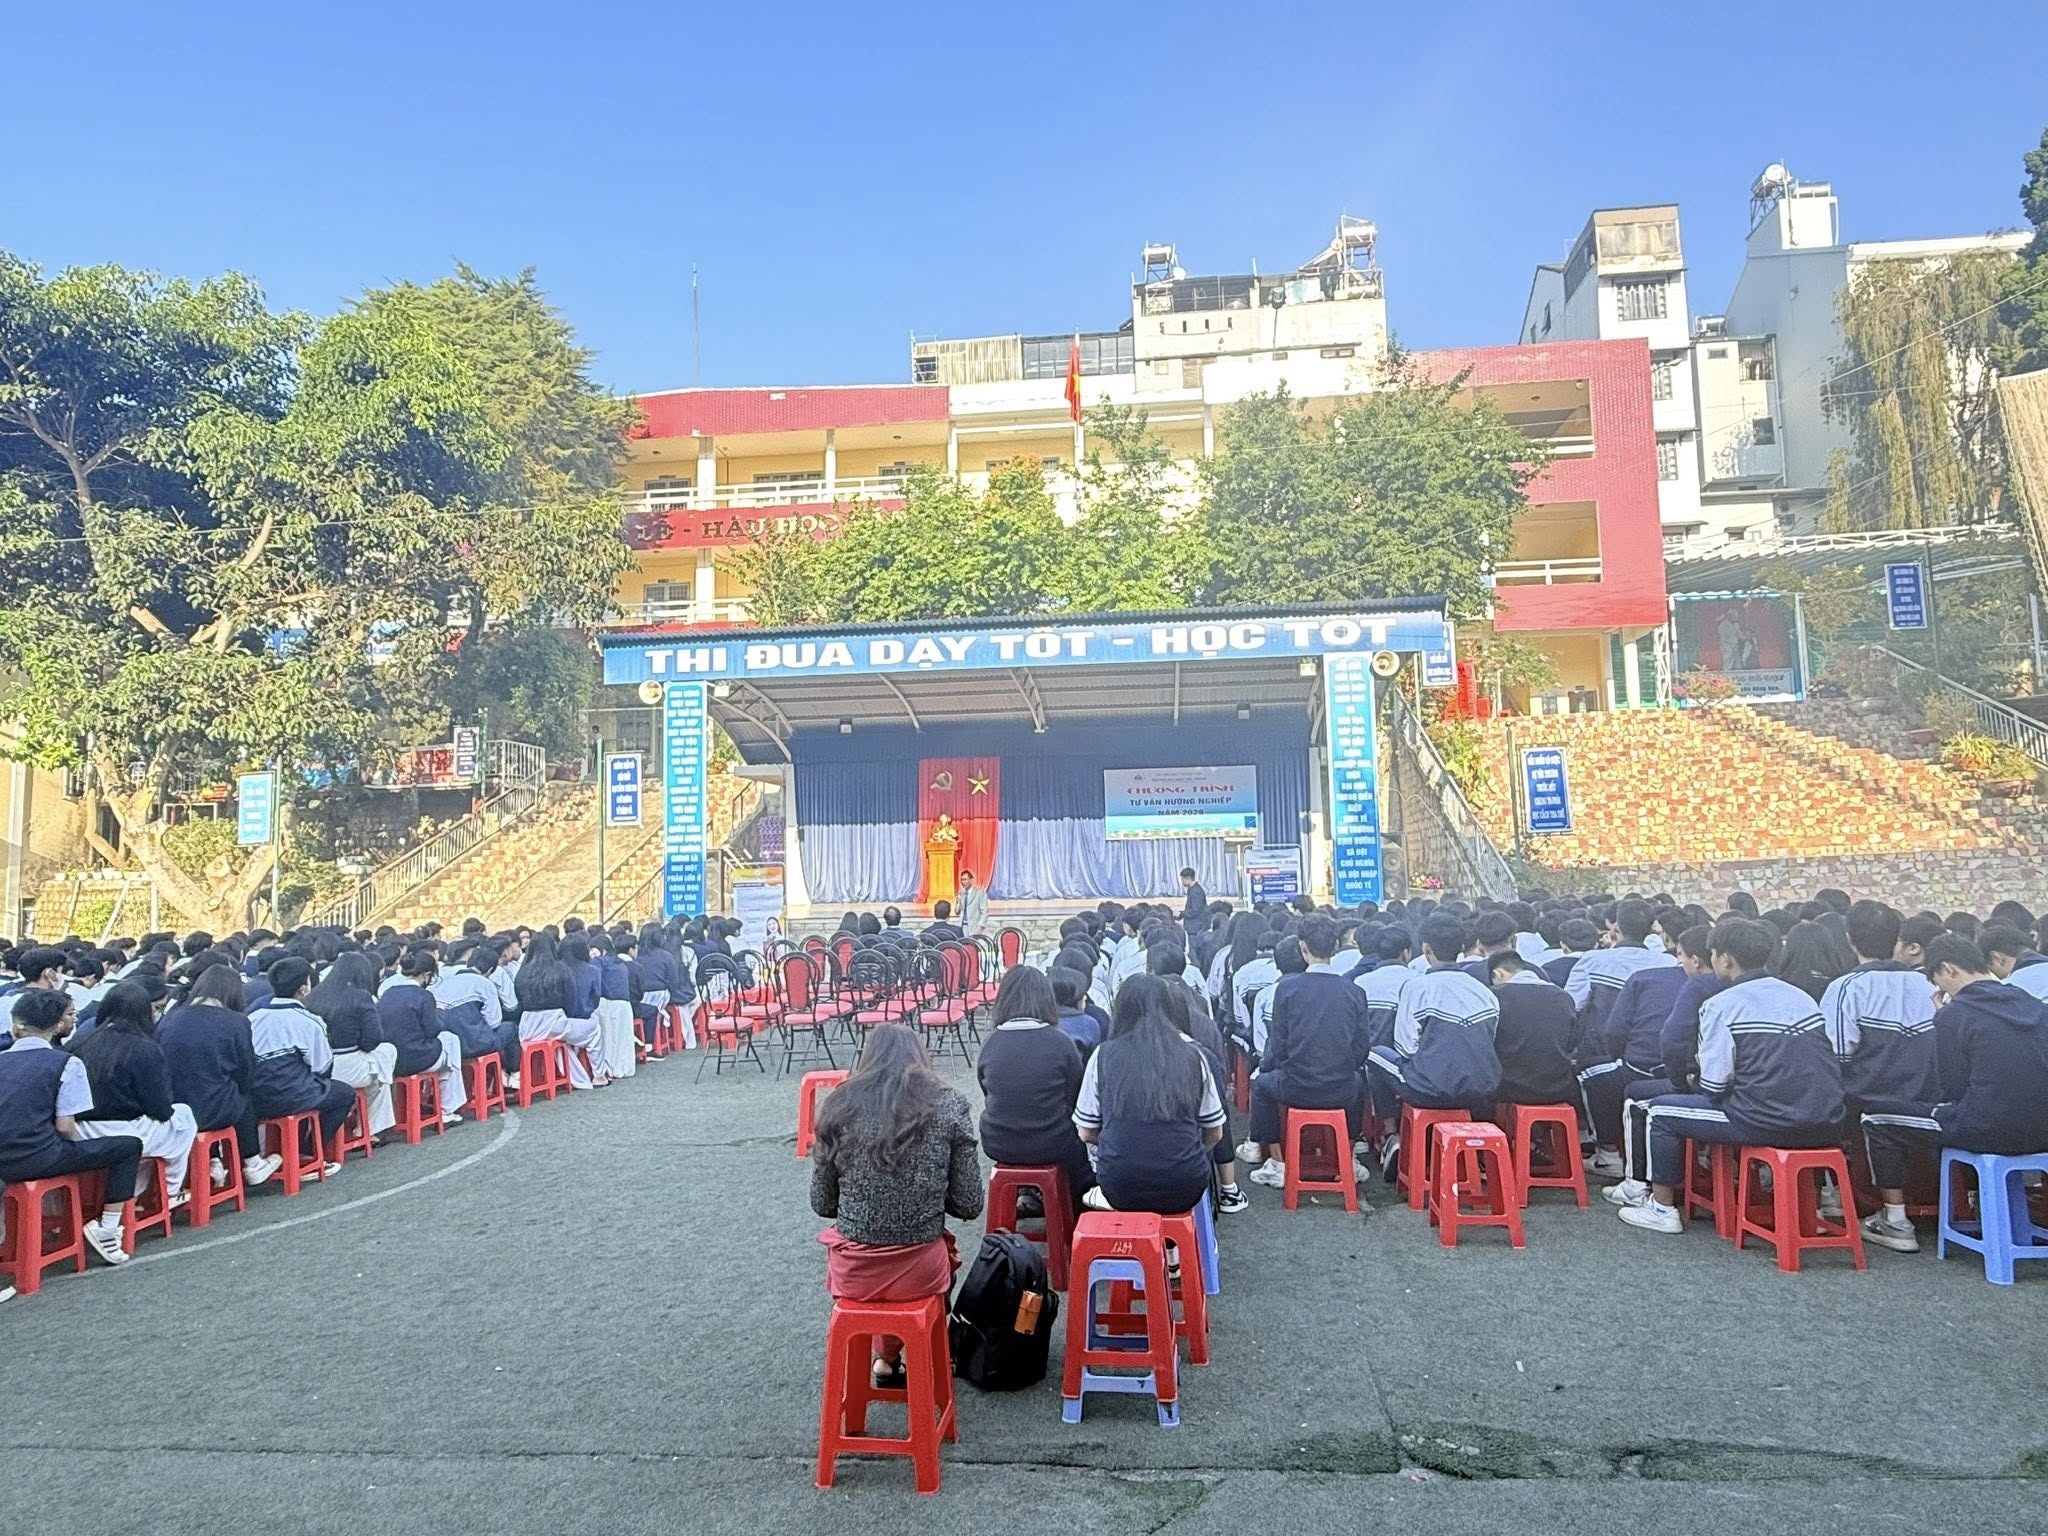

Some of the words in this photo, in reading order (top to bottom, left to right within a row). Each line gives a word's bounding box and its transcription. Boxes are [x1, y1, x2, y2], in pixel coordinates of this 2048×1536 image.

[645, 647, 727, 674] THI
[744, 641, 855, 670] ĐUA
[869, 635, 977, 669] DẠY
[1151, 622, 1267, 657] HỌC
